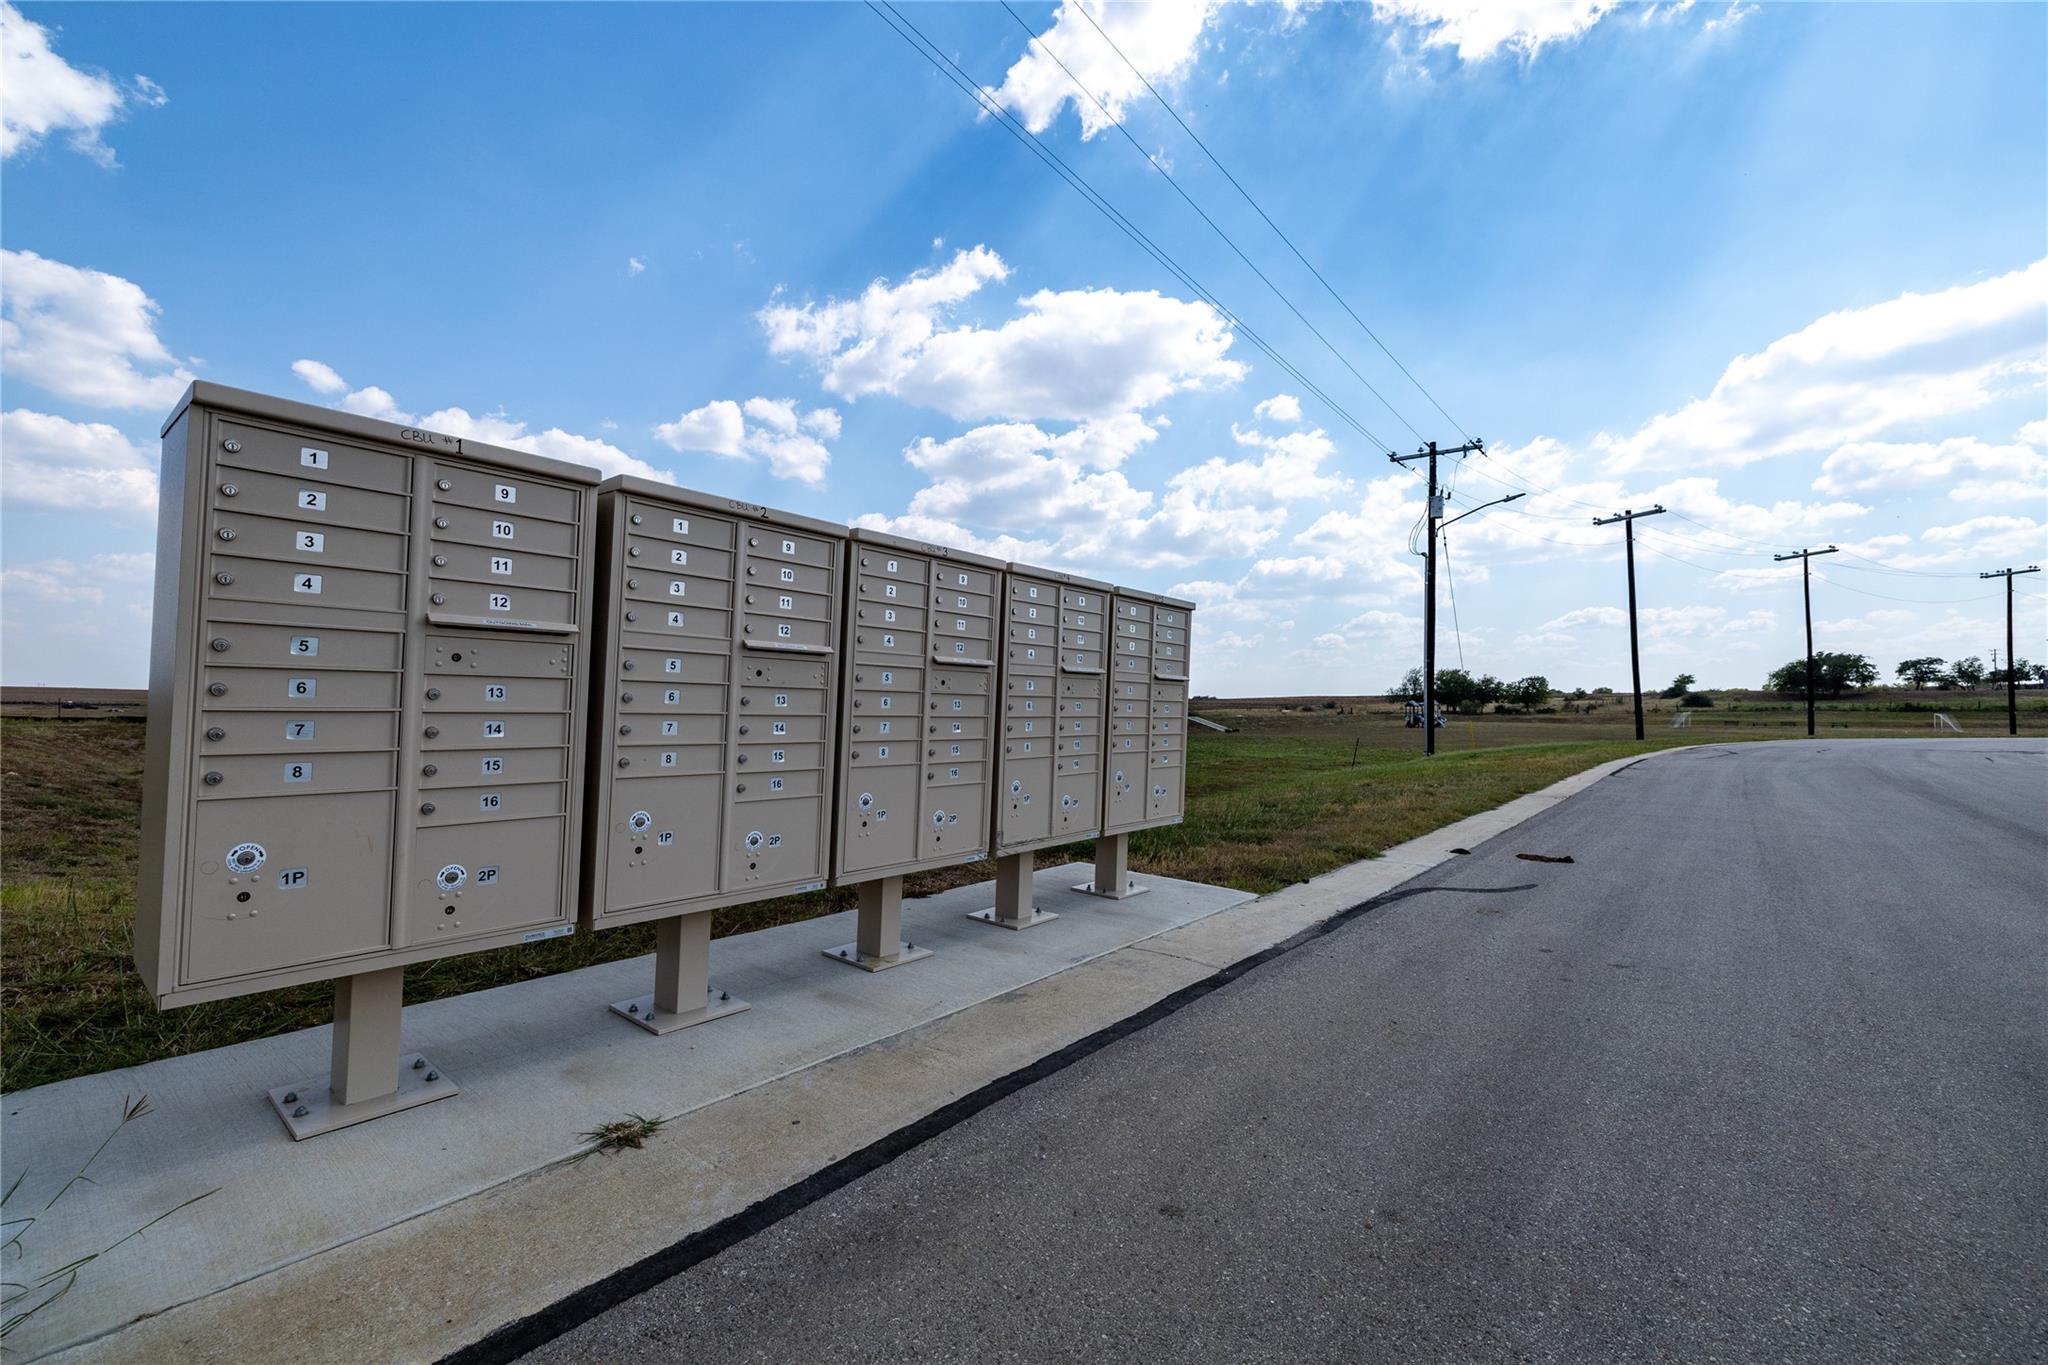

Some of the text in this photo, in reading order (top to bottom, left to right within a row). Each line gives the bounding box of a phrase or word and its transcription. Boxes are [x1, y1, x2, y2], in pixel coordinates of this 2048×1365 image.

[401, 429, 434, 444] CBU
[310, 453, 316, 464] 1
[501, 489, 508, 499] 9
[307, 494, 316, 505] 2
[496, 525, 510, 535] 10
[677, 522, 683, 530] 1
[305, 536, 314, 547] 3
[675, 553, 682, 561] 2
[495, 560, 507, 571] 11
[783, 571, 792, 579] 10
[960, 575, 965, 584] 9
[302, 578, 312, 589] 4
[673, 584, 681, 592] 3
[493, 597, 507, 607] 12
[672, 615, 679, 623] 4
[781, 627, 789, 635] 12
[886, 636, 891, 644] 4
[299, 640, 308, 652] 5
[670, 661, 677, 670] 5
[297, 682, 306, 693] 6
[489, 688, 503, 698] 13
[668, 692, 675, 701] 6
[777, 696, 785, 704] 13
[295, 724, 304, 735] 7
[486, 724, 501, 734] 14
[666, 724, 673, 732] 7
[775, 724, 784, 732] 14
[882, 723, 887, 731] 7
[774, 752, 783, 760] 15
[880, 748, 886, 756] 8
[665, 755, 672, 763] 8
[485, 760, 500, 770] 15
[293, 766, 302, 778] 8
[773, 780, 781, 788] 16
[483, 796, 498, 807] 16
[660, 833, 671, 842] 1P
[770, 836, 780, 845] 2P
[282, 872, 304, 884] 1P
[478, 870, 496, 881] 2P
